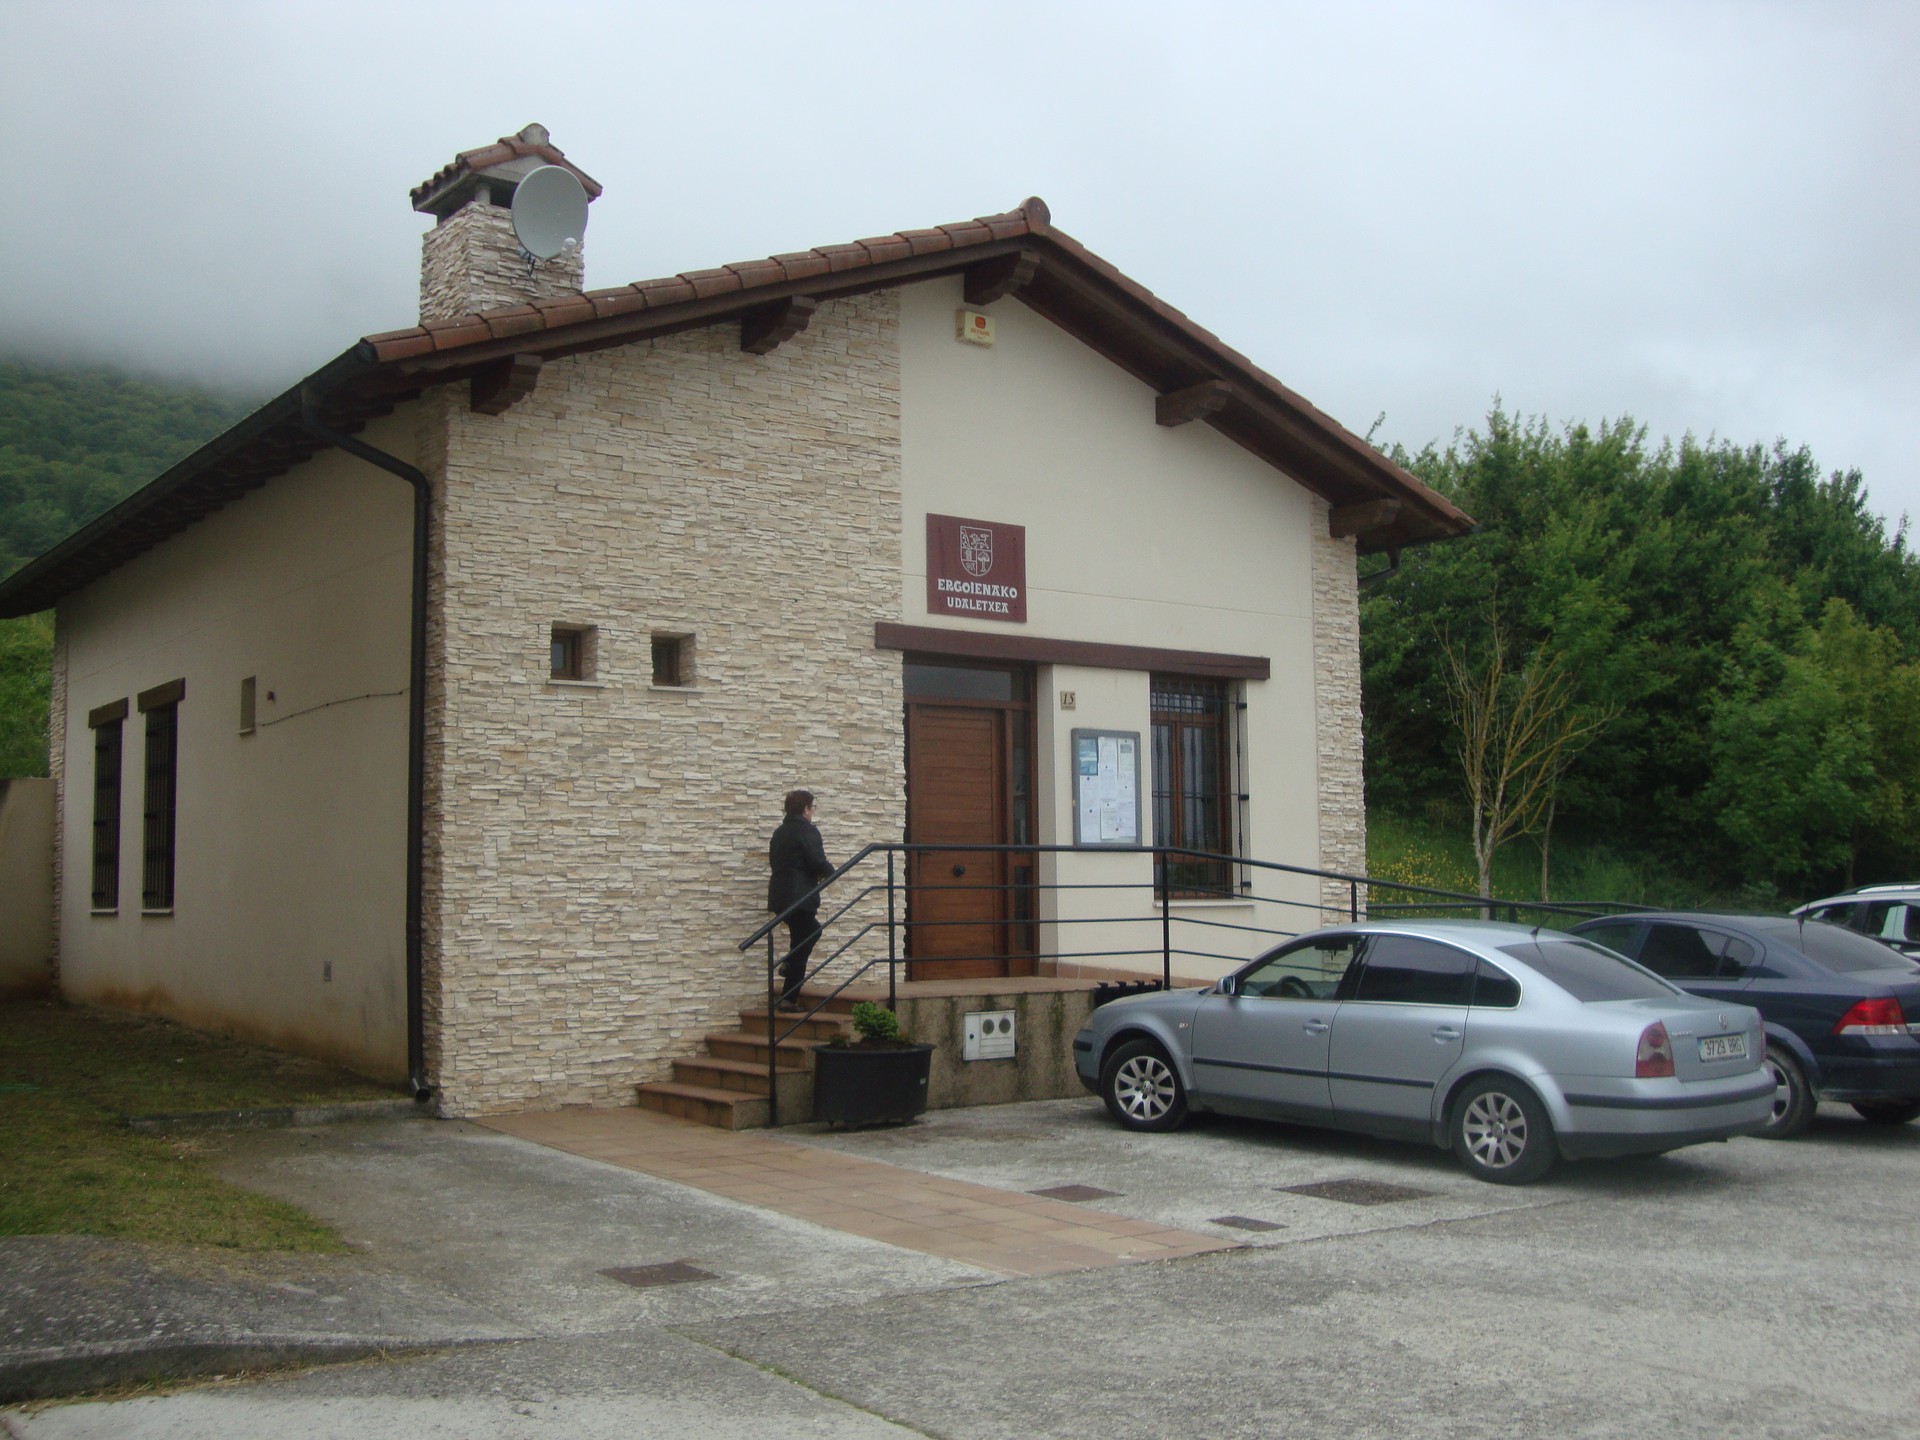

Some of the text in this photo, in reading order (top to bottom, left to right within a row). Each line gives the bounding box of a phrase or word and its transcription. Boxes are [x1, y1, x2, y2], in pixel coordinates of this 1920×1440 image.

[937, 578, 1018, 599] ERGOIENAKO
[946, 596, 1009, 614] UDALETXEA
[1062, 692, 1076, 705] 15
[1704, 1040, 1726, 1056] 3729
